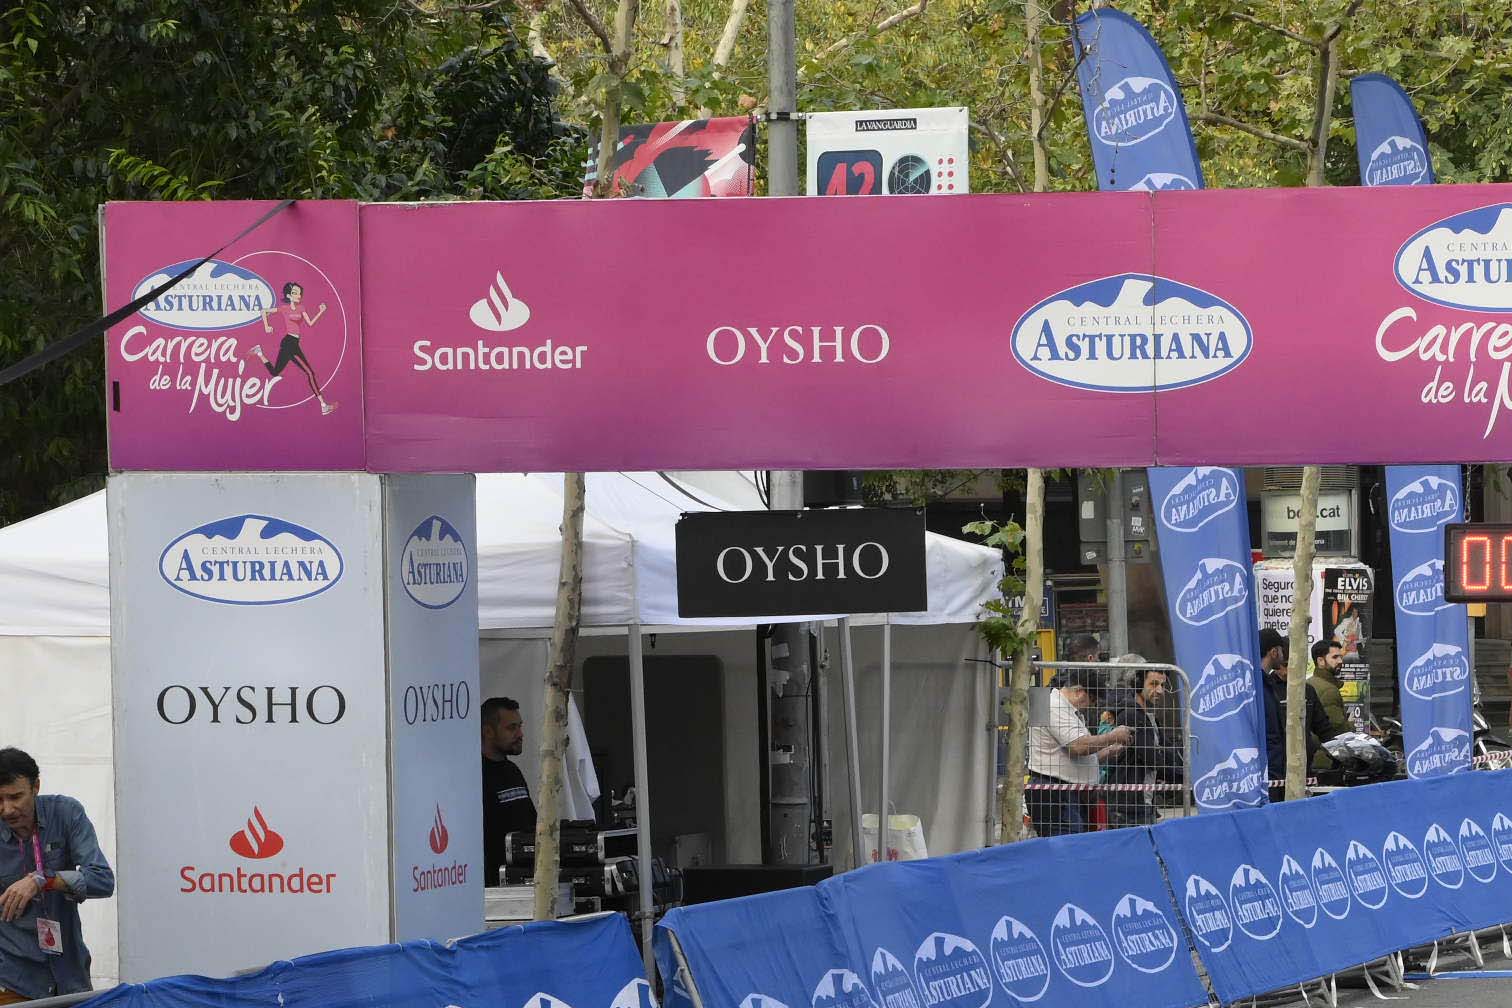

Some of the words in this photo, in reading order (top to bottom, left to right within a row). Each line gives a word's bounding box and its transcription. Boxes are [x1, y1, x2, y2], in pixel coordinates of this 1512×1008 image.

[827, 161, 876, 196] 42
[168, 282, 209, 292] ENTRAL
[214, 282, 261, 291] LECHERA
[1067, 315, 1141, 327] CENTRAL
[1149, 314, 1225, 325] LECHERA
[120, 326, 239, 363] Carrera
[413, 339, 589, 371] Santander
[706, 324, 892, 366] OYSHO
[1030, 318, 1234, 362] ASTURIANA
[150, 365, 172, 391] de
[176, 364, 191, 391] la
[189, 362, 283, 422] Mujer
[1420, 365, 1457, 404] de
[1463, 363, 1489, 403] la
[174, 549, 330, 583] ASTURIANA
[201, 546, 260, 556] CENTRAL
[265, 546, 324, 556] LECHERA
[716, 541, 891, 584] OYSHO
[406, 551, 465, 586] ASTURIANA
[1338, 577, 1368, 590] ELVIS
[1262, 594, 1279, 605] que
[1263, 606, 1295, 618] quiere
[156, 684, 347, 726] OYSHO
[403, 680, 471, 726] OYSHO
[180, 865, 337, 894] Santander
[412, 860, 469, 893] Santander
[995, 951, 1048, 984] ASTURIANA
[1056, 937, 1112, 970] ASTURIANA
[919, 966, 991, 1006] ASTURIANA
